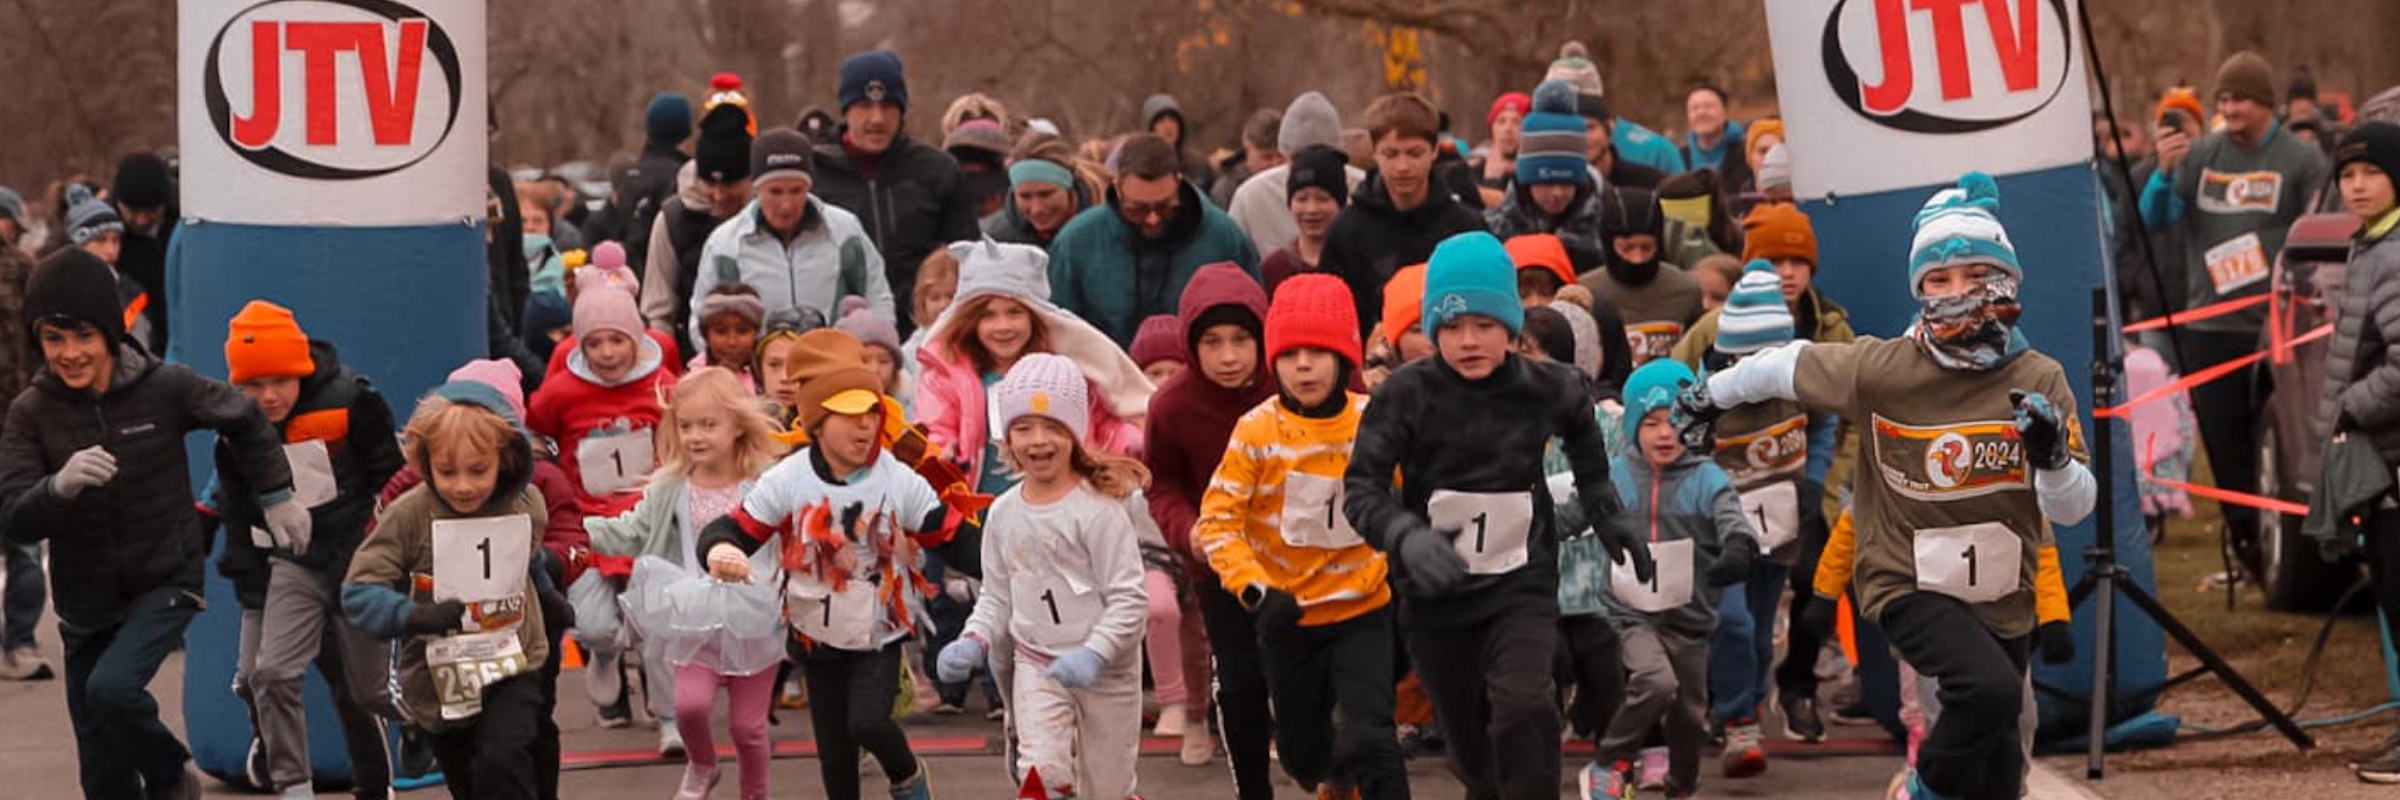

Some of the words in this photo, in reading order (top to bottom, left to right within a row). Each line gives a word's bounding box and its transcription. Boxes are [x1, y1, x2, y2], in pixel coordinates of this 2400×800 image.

[1862, 0, 2040, 112] JTV
[232, 20, 427, 147] JTV
[609, 448, 623, 478] 1
[1974, 442, 2020, 470] 2024
[1324, 491, 1336, 531] 1
[1753, 503, 1769, 534] 1
[1471, 512, 1486, 554] 1
[476, 536, 491, 580] 1
[1961, 544, 1977, 588] 1
[819, 593, 831, 628] 1
[1040, 588, 1062, 625] 1
